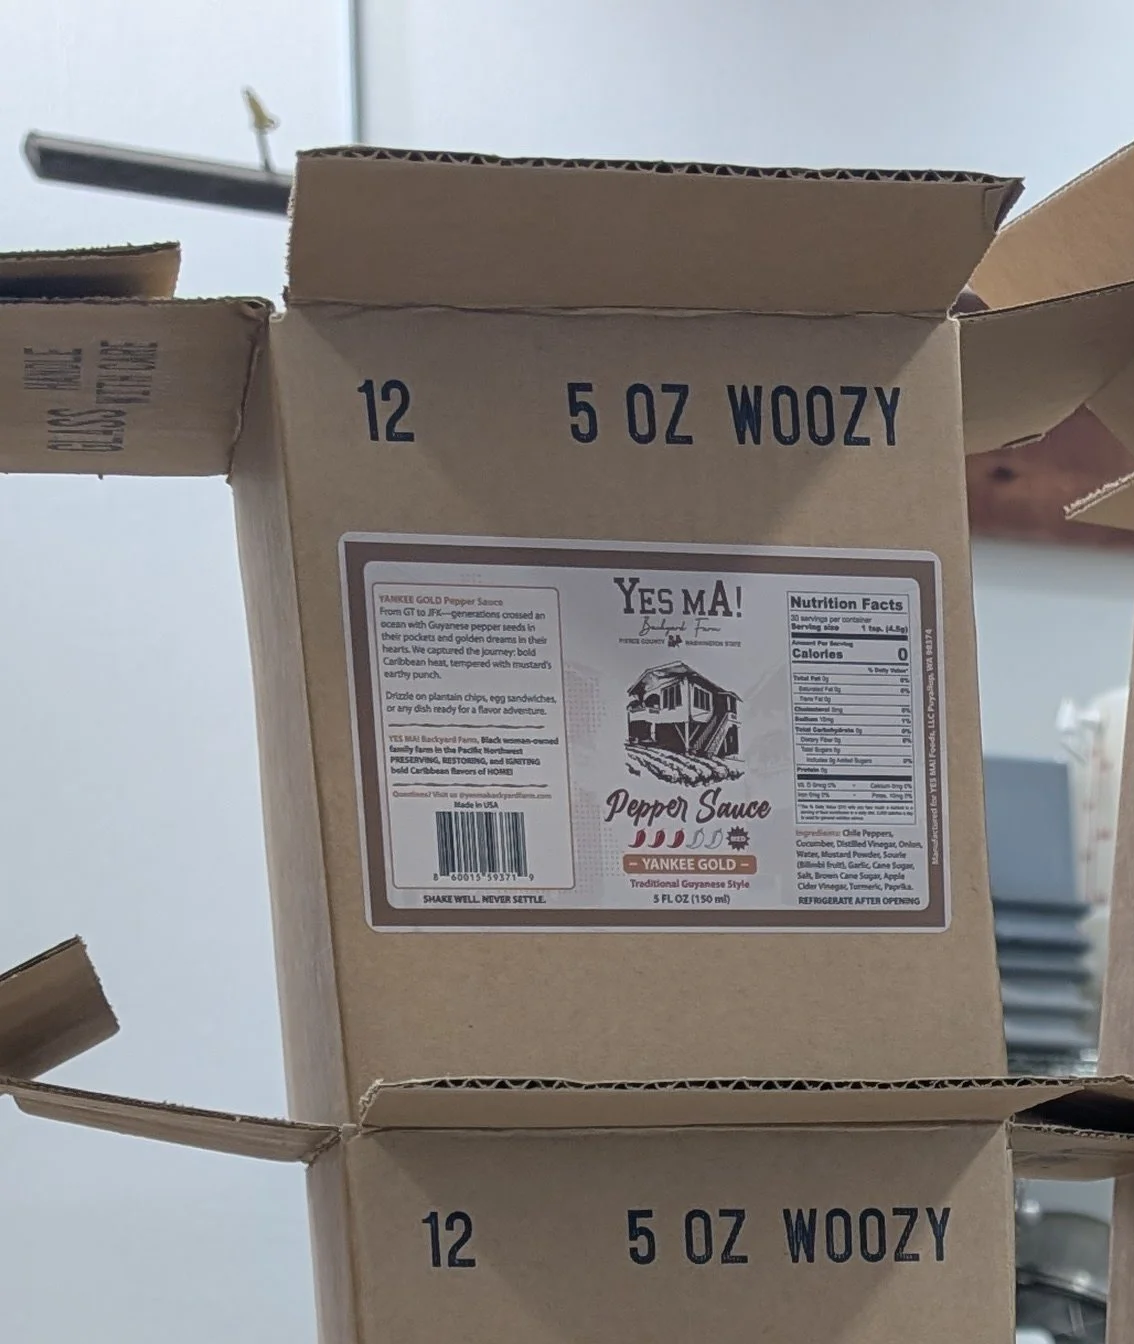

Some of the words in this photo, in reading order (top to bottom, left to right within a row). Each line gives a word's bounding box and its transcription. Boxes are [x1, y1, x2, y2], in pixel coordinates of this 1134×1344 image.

[357, 380, 415, 443] 12
[567, 382, 598, 445] 5
[625, 383, 693, 446] OZ
[727, 384, 901, 446] WOOZY
[47, 408, 126, 451] GLASS
[613, 576, 673, 615] YES
[790, 595, 857, 609] Nutrition
[861, 597, 903, 611] Facts
[379, 608, 402, 616] From
[403, 608, 416, 617] GT
[416, 609, 426, 617] to
[501, 610, 533, 620] crossed
[534, 612, 545, 620] an
[791, 647, 843, 659] Calories
[897, 647, 908, 661] 0
[603, 788, 688, 827] Pepper
[694, 786, 772, 824] Sauce
[641, 857, 695, 870] YANKEE
[697, 858, 736, 870] GOLD
[629, 878, 680, 888] Traditional
[681, 879, 726, 890] Guyanese
[727, 879, 750, 890] Style
[653, 893, 660, 903] 5
[661, 894, 673, 904] FL
[674, 894, 689, 904] OZ
[690, 894, 713, 905] (150
[714, 893, 730, 904] ml)
[798, 896, 853, 905] REFRIGERATE
[854, 896, 881, 905] AFTER
[882, 896, 920, 905] OPENING
[421, 1210, 476, 1269] 12
[627, 1209, 656, 1266] 5
[684, 1208, 749, 1266] OZ
[782, 1206, 951, 1264] WOOZY
